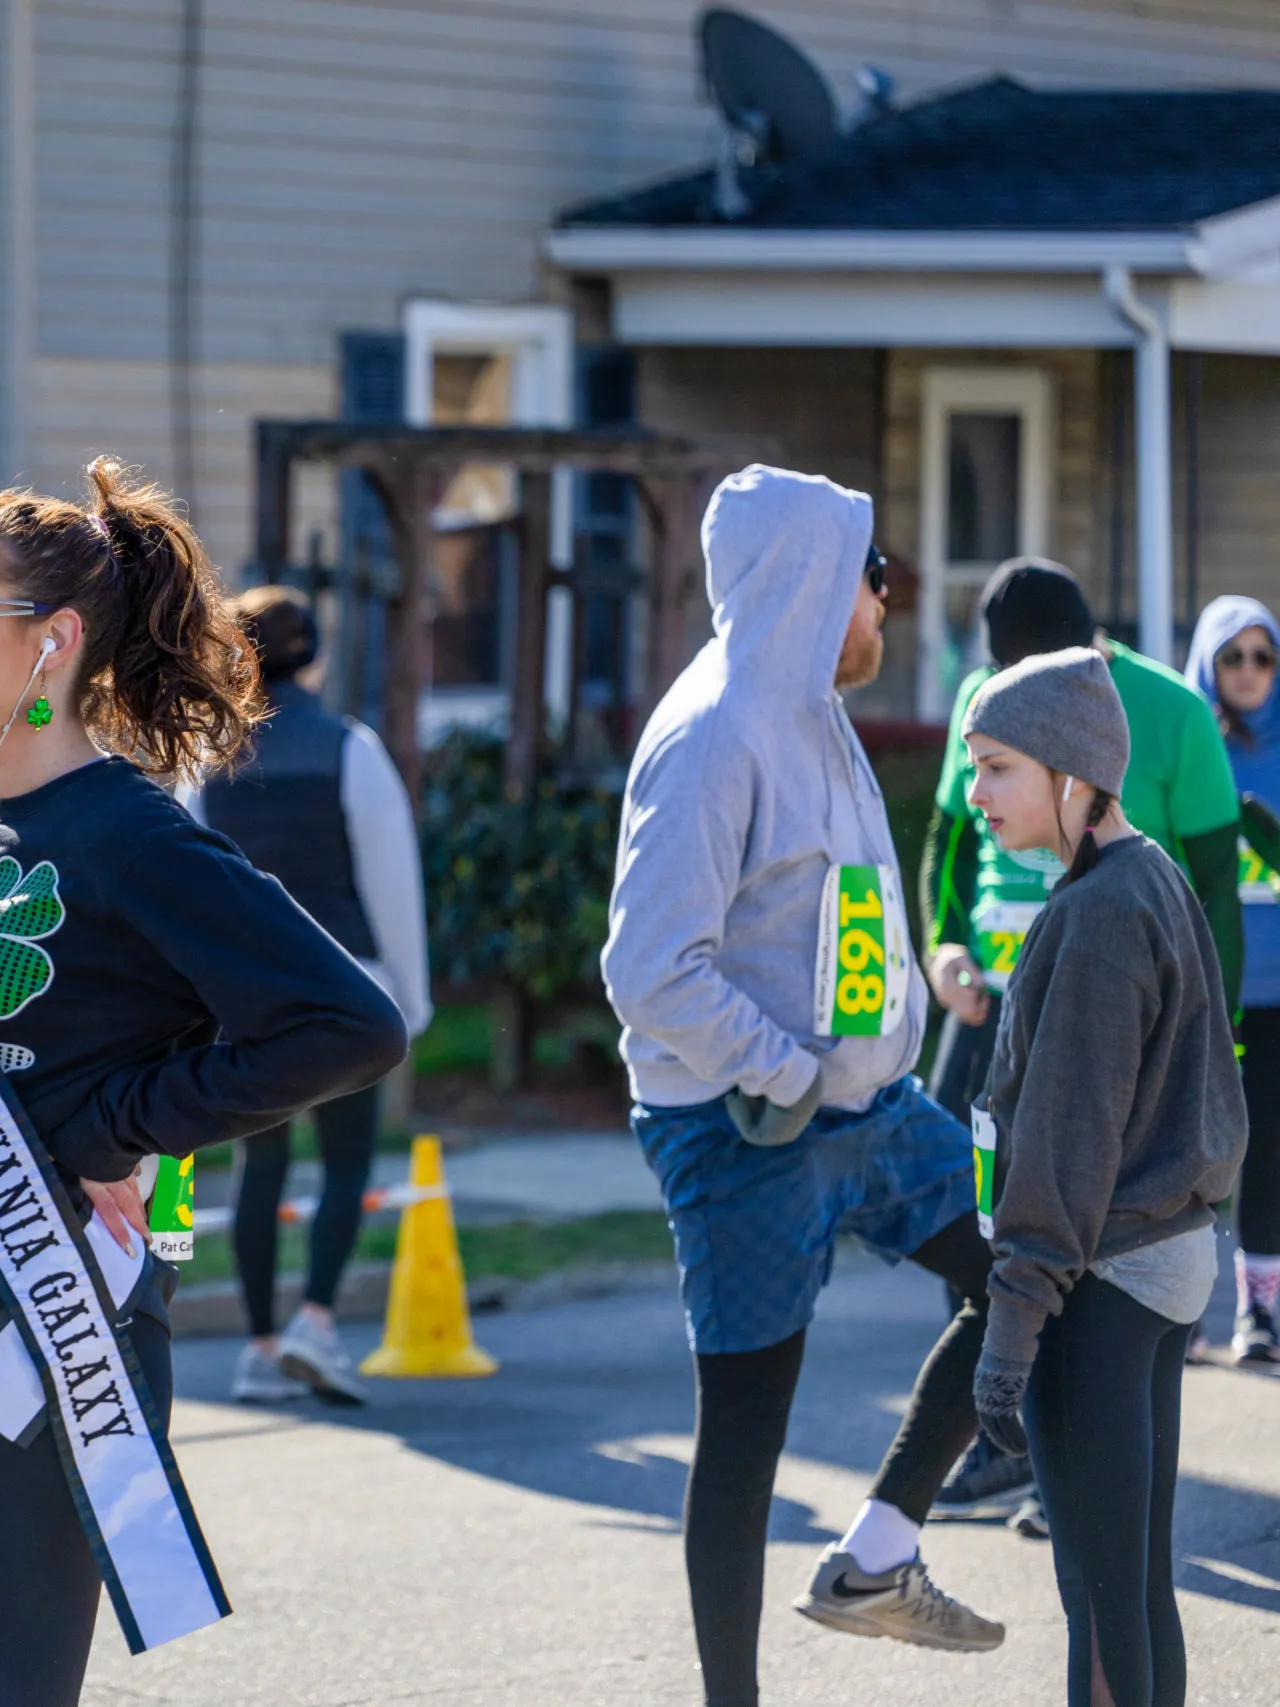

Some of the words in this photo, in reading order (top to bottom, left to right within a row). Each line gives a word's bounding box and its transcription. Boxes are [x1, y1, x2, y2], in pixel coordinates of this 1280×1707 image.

[836, 887, 885, 1015] 168
[990, 931, 1027, 974] 2
[160, 1241, 177, 1252] Pat
[29, 1271, 135, 1447] GALAXY
